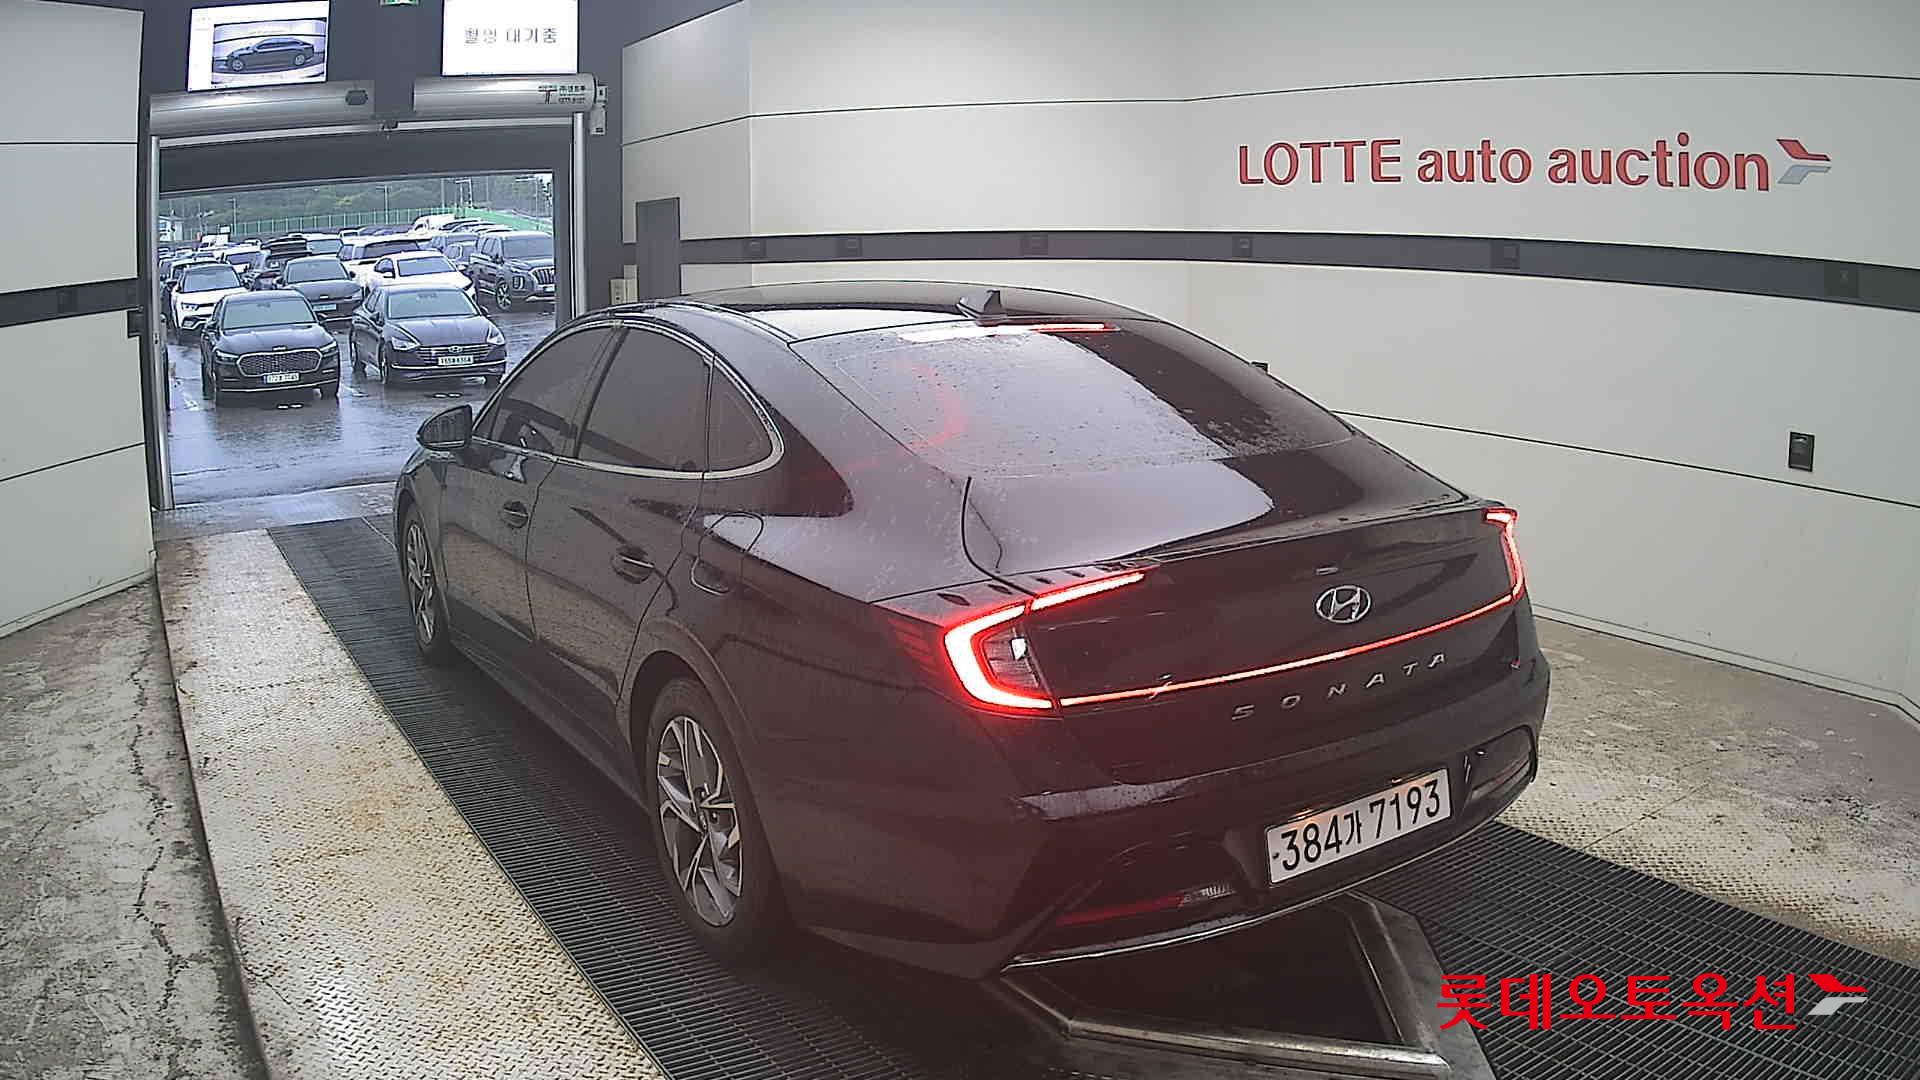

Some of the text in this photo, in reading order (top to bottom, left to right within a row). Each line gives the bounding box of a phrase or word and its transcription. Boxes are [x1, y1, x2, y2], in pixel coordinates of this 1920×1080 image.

[504, 27, 557, 44] 대기중
[1238, 131, 1769, 191] LOTTE auto auction
[1232, 652, 1446, 721] SONATA
[1280, 779, 1441, 872] 384가 7193
